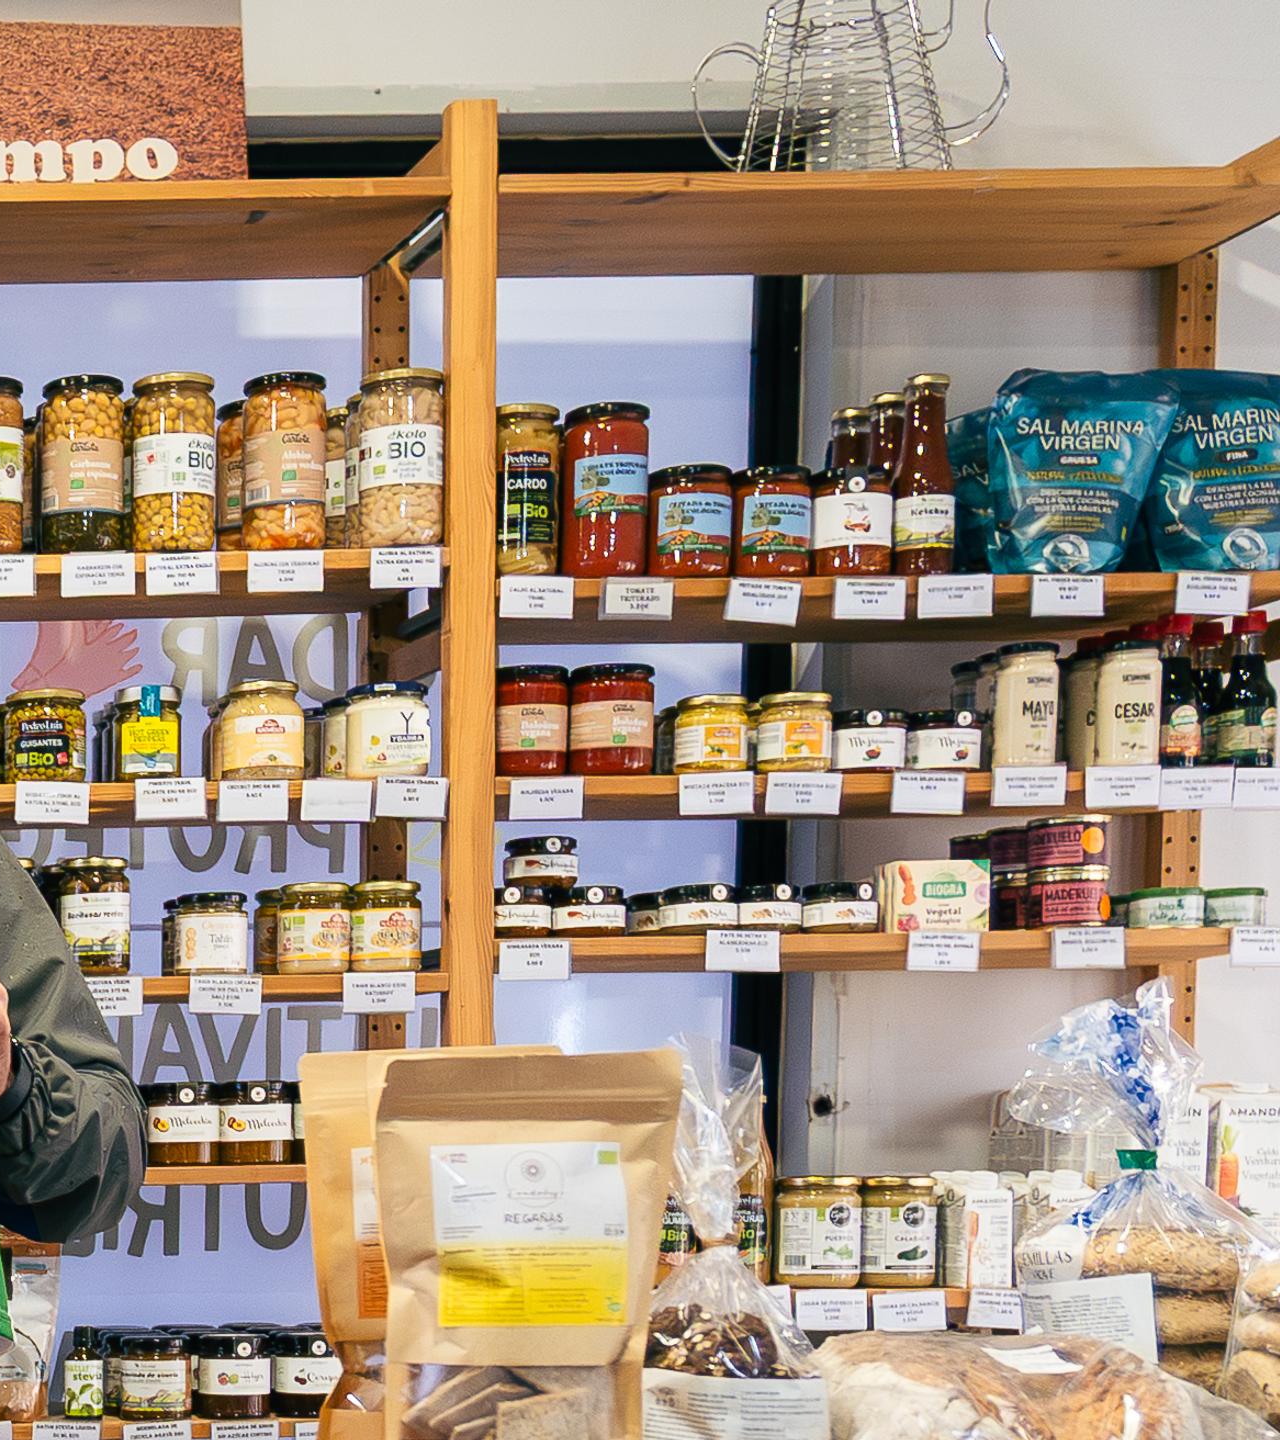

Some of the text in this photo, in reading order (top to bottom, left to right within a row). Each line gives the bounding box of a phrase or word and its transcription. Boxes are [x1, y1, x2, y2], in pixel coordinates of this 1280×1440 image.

[1016, 417, 1146, 437] SAL MARINA
[1171, 413, 1209, 434] SAL
[1039, 434, 1122, 452] VIRGEN
[1193, 426, 1275, 451] VIRGEN
[388, 440, 427, 460] BIO
[1225, 450, 1249, 461] FINA
[188, 451, 214, 470] BIO
[507, 477, 547, 490] CARDO
[1022, 700, 1055, 717] MAYO
[1114, 702, 1155, 720] CESAR
[20, 738, 64, 749] GUISANTES
[925, 906, 962, 917] Vegetal
